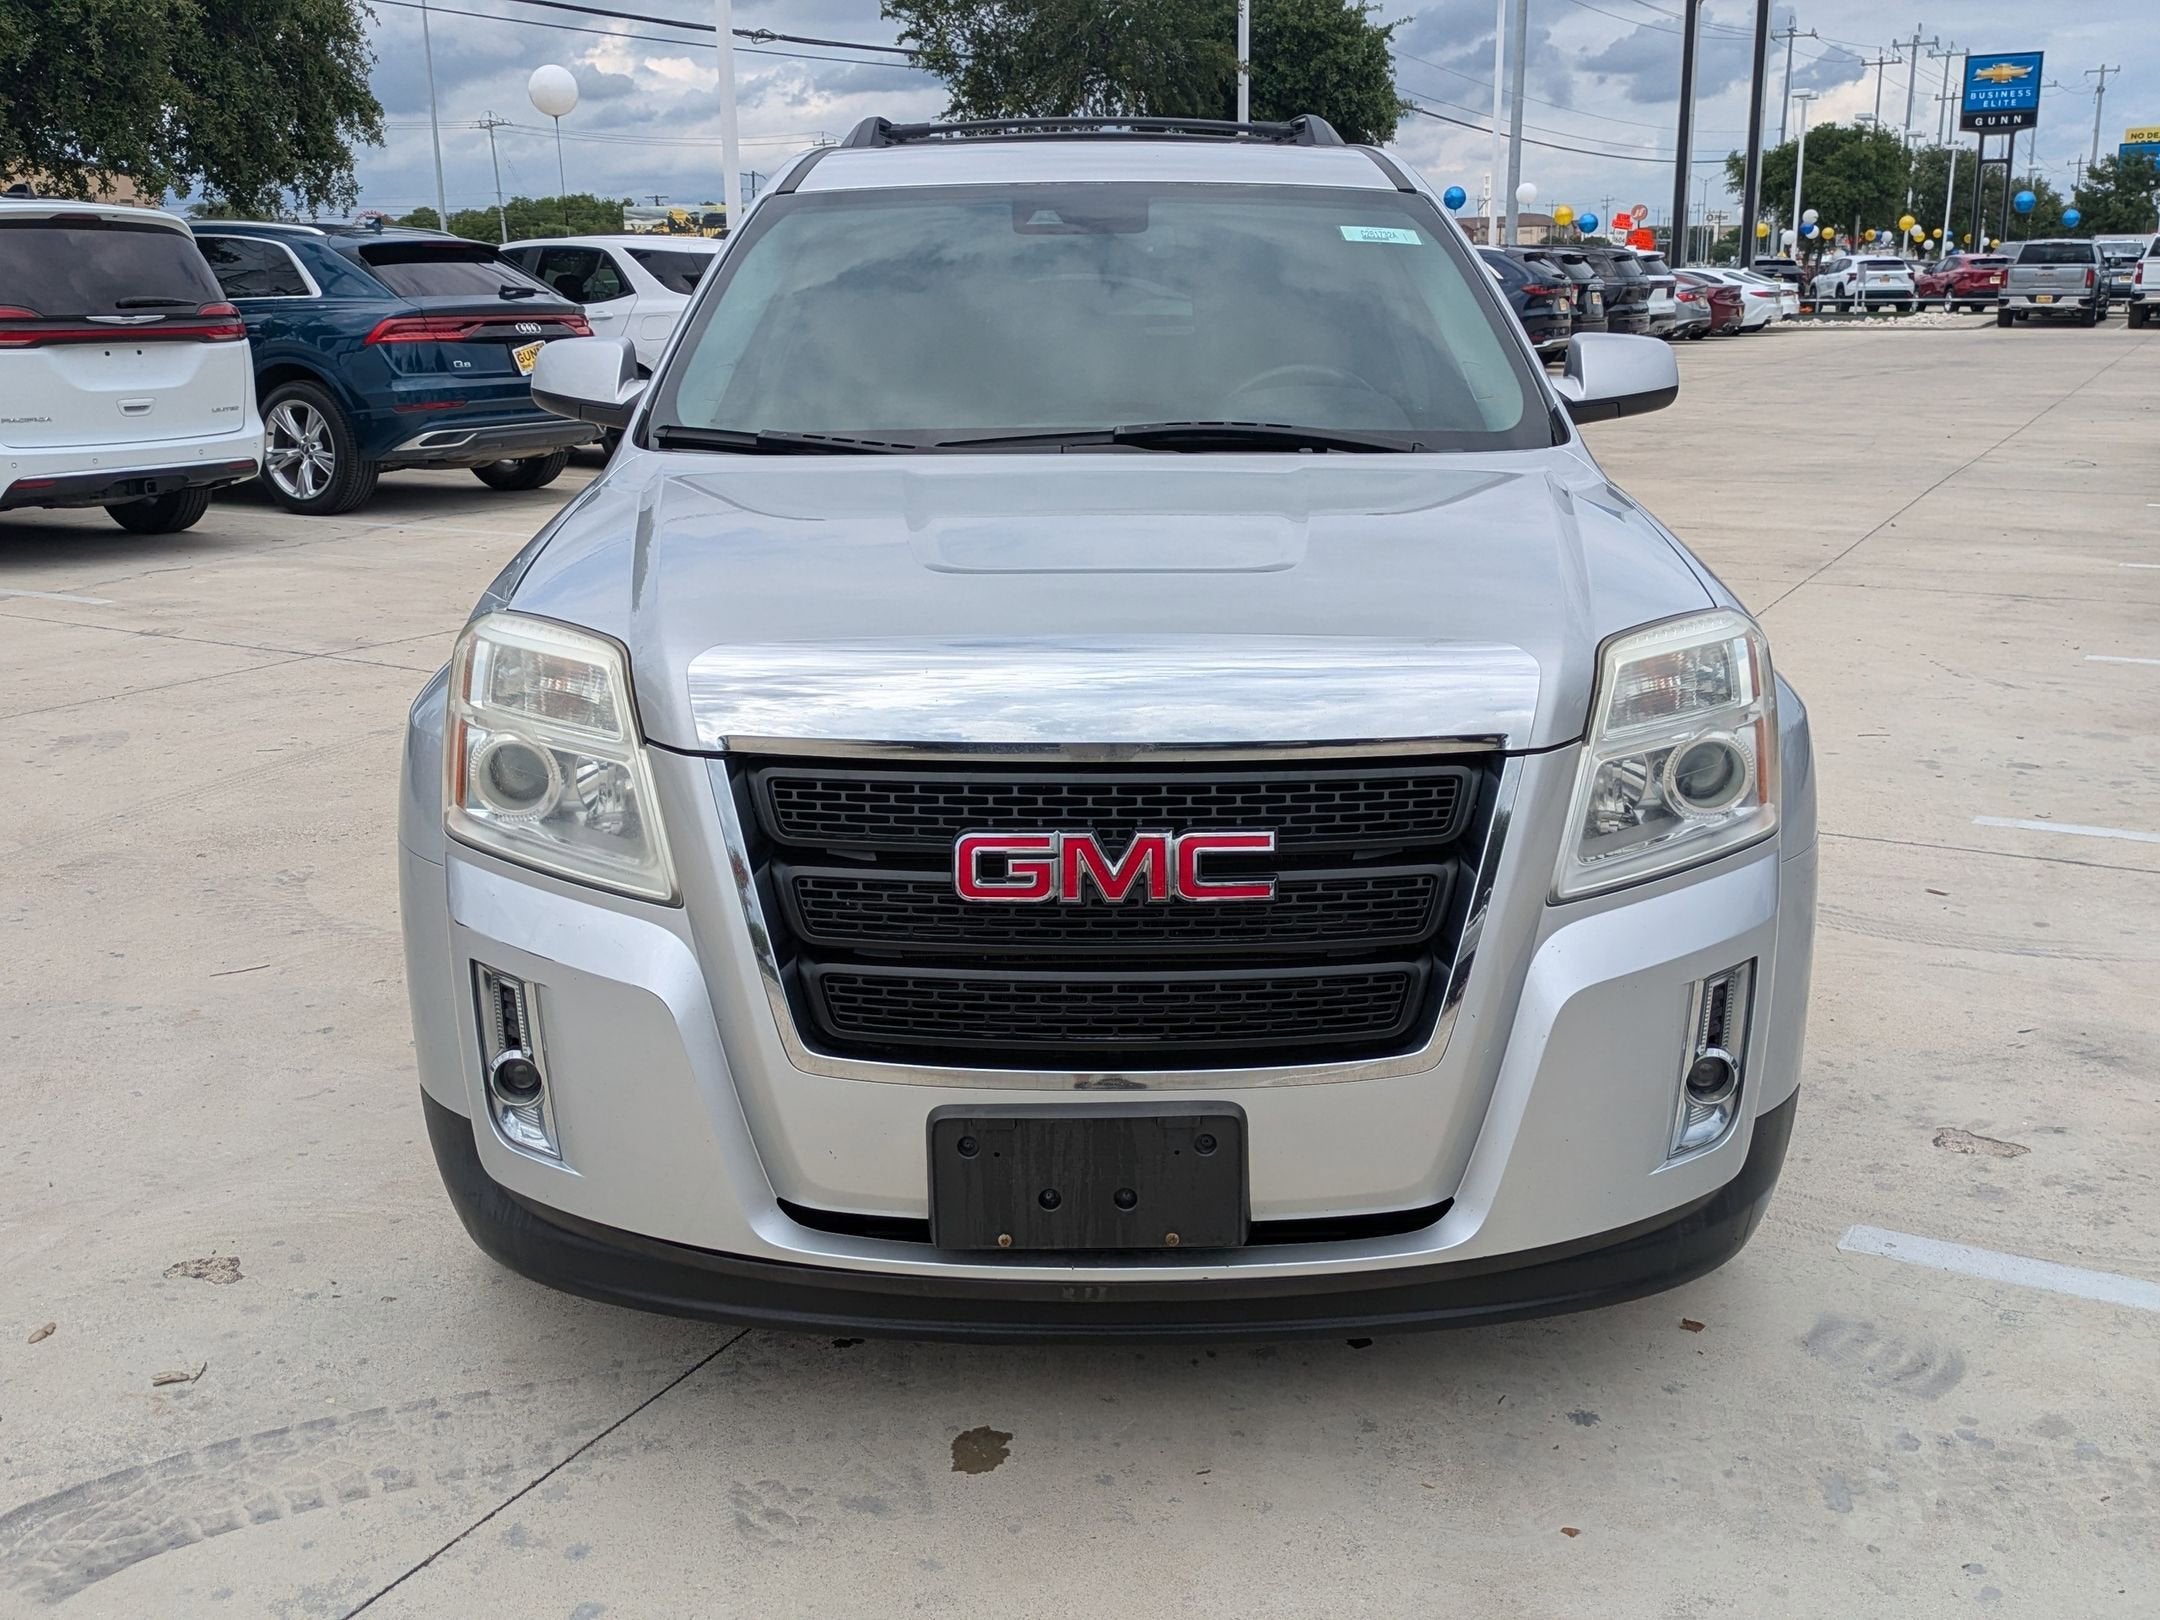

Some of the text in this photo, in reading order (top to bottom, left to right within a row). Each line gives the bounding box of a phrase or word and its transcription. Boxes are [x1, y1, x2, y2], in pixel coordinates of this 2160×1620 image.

[1970, 90, 2031, 100] BUSINESS
[1983, 99, 2016, 107] ELITE
[1975, 115, 2022, 126] GUNN
[453, 360, 471, 368] Q8
[955, 831, 1276, 903] GMC
